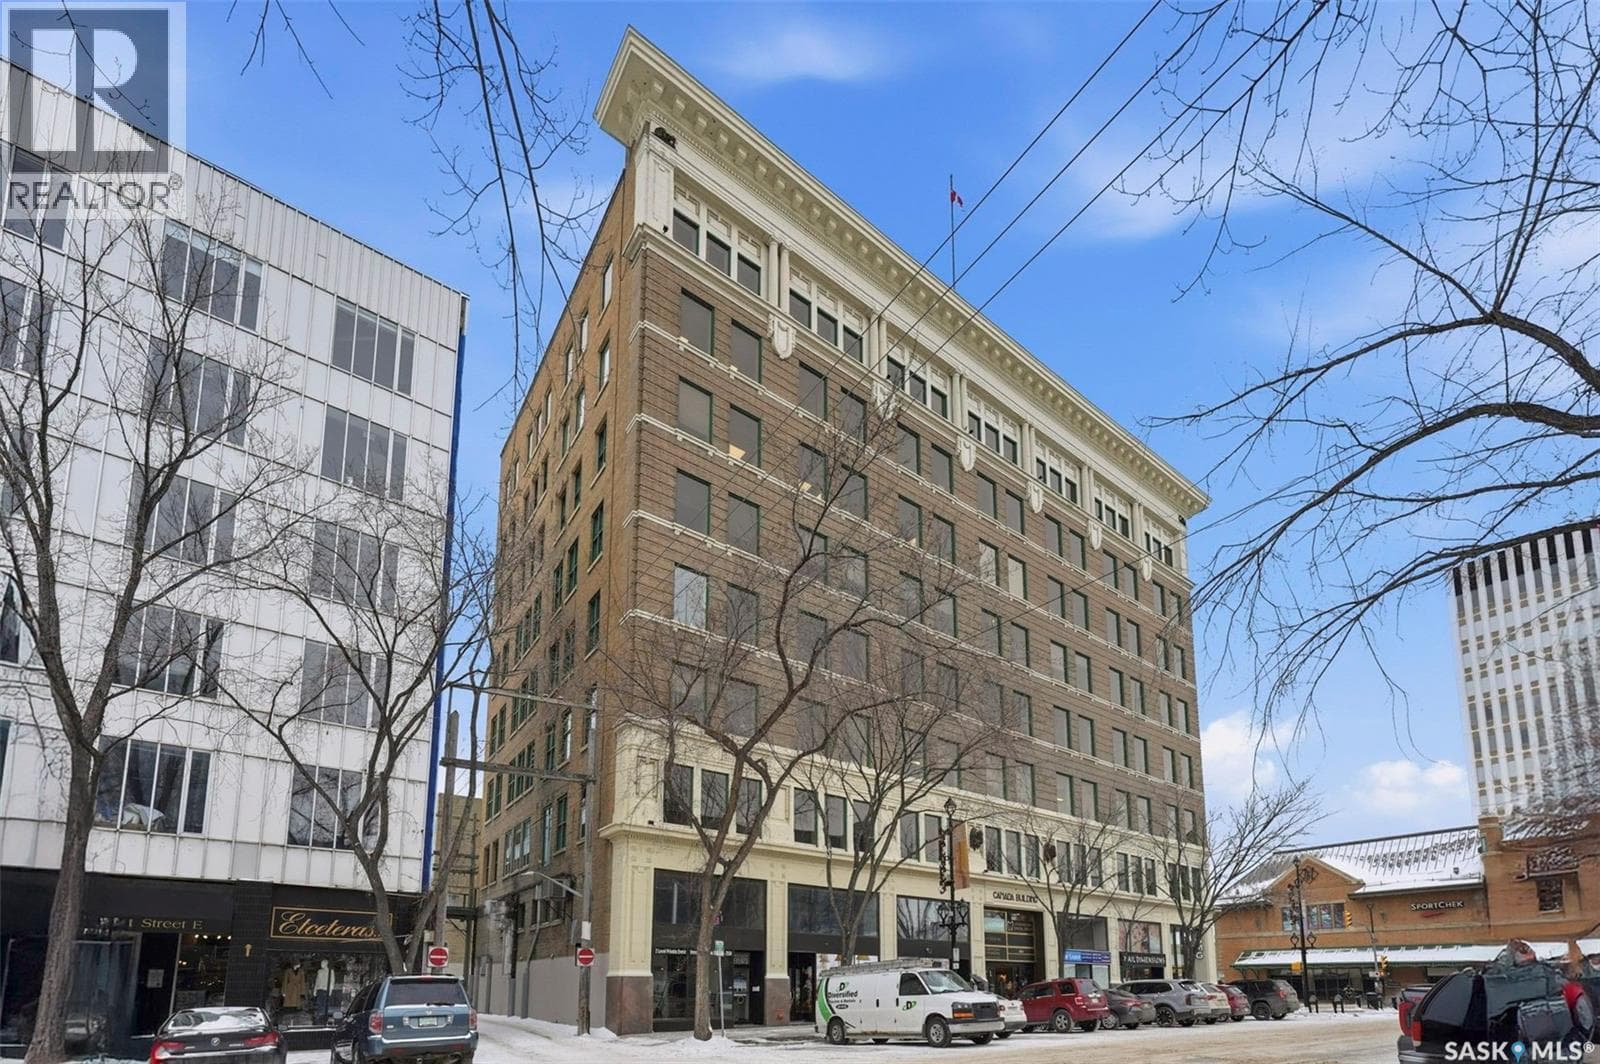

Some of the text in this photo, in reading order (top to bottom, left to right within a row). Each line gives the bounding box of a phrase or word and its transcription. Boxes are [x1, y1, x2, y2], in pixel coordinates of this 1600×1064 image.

[140, 918, 186, 929] Street
[192, 920, 203, 930] E
[827, 990, 858, 998] Diversified
